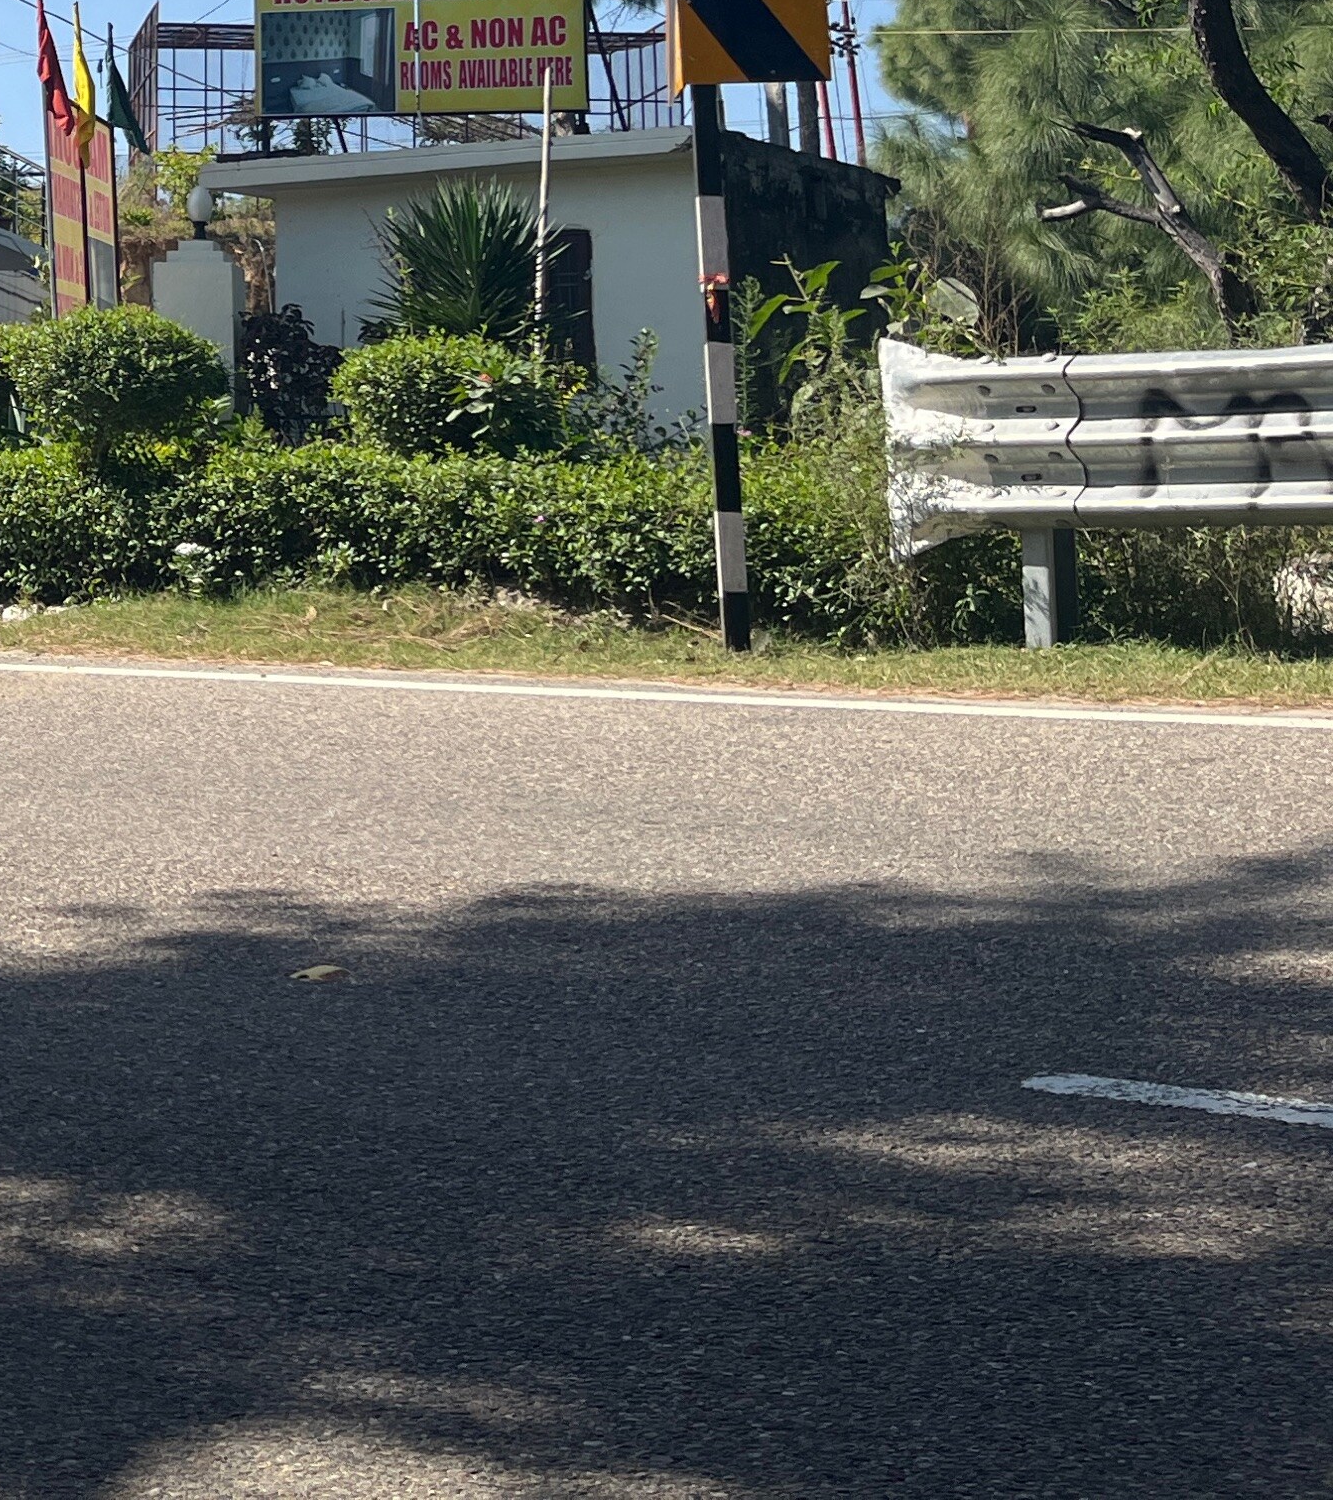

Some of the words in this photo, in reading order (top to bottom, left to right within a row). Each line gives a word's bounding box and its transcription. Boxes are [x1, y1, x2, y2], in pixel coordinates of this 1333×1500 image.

[403, 20, 438, 51] AC
[445, 24, 464, 50] &
[470, 17, 523, 48] NON
[531, 15, 566, 46] AC
[458, 57, 533, 89] AVAILABLE
[536, 56, 572, 86] HERE
